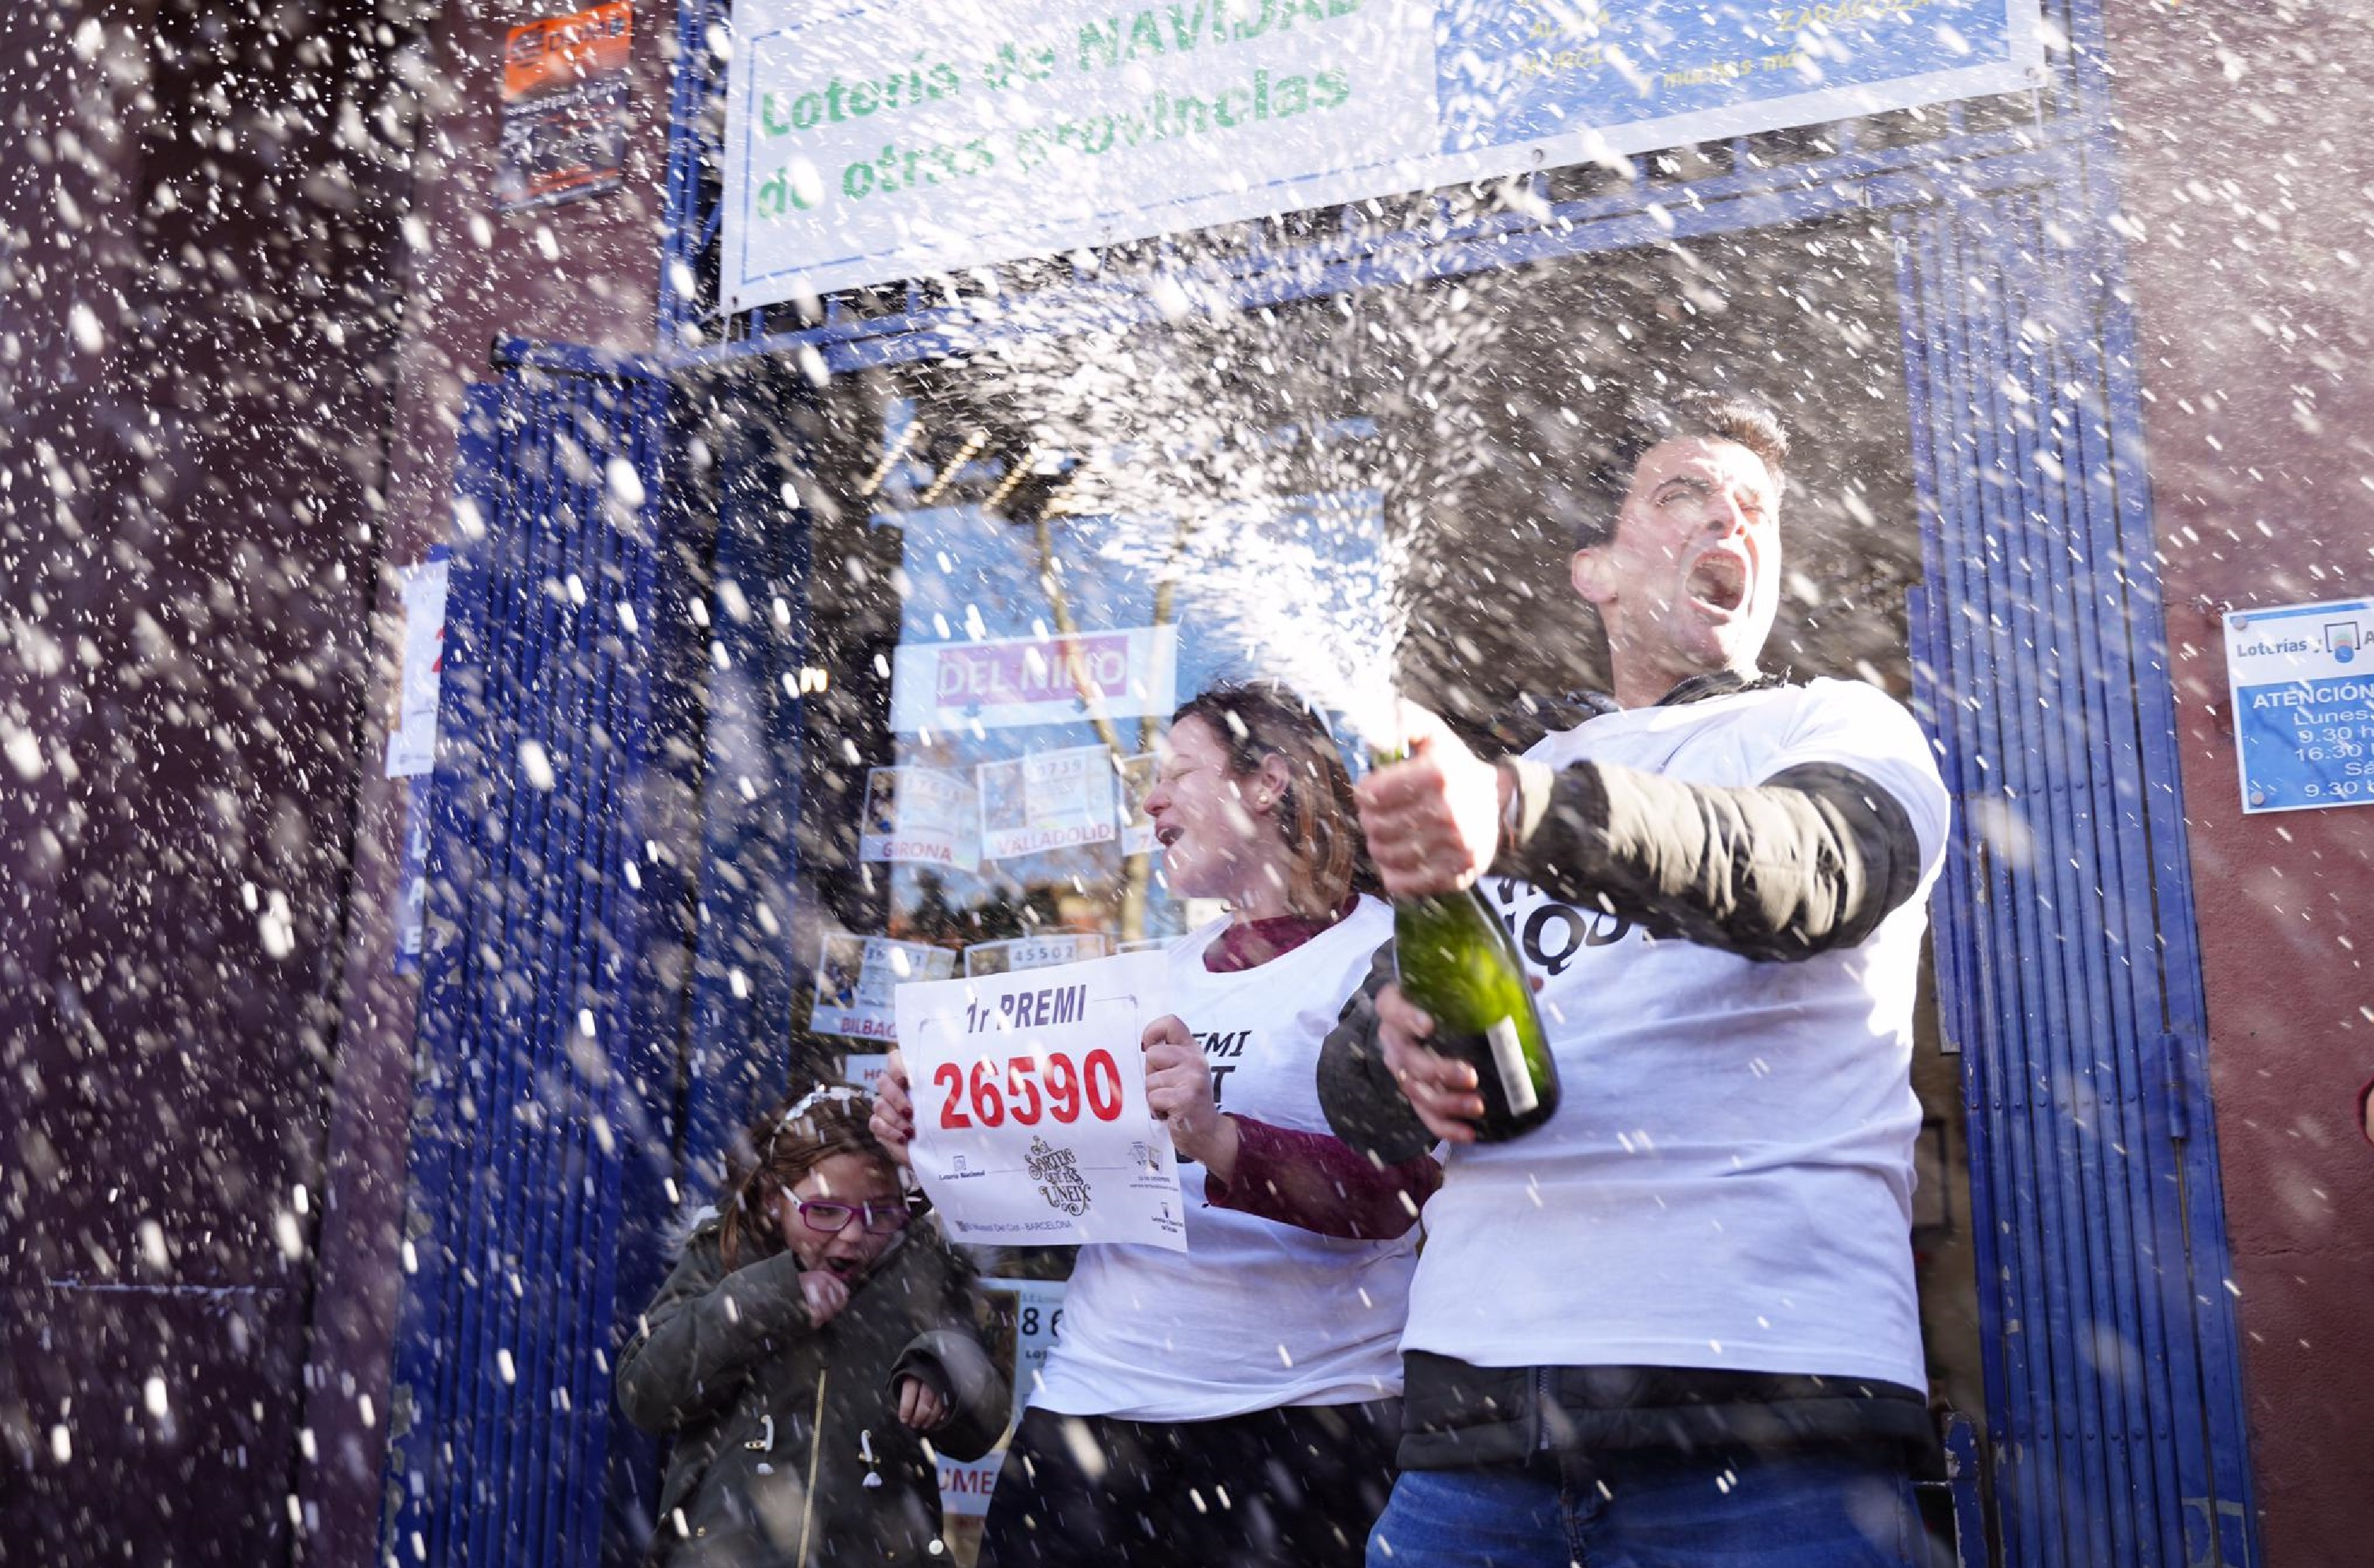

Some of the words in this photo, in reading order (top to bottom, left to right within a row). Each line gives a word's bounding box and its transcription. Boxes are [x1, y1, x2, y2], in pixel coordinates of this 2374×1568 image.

[1776, 0, 1931, 31] ZARAGOZ
[1520, 41, 1621, 76] MURCI
[1763, 43, 1805, 72] má
[762, 50, 960, 136] Lotería
[1016, 67, 1350, 174] provincias
[2236, 638, 2307, 657] Loterías
[940, 660, 1008, 697] DEL
[2253, 682, 2374, 708] ATENCIÓN
[2304, 781, 2358, 797] 9.30
[882, 841, 952, 864] GIRONA
[997, 823, 1111, 855] VALLADOLID
[967, 996, 990, 1034] 1r
[997, 984, 1086, 1031] PREMI
[934, 1048, 1123, 1130] 26590
[1025, 1220, 1072, 1231] BARCELONA
